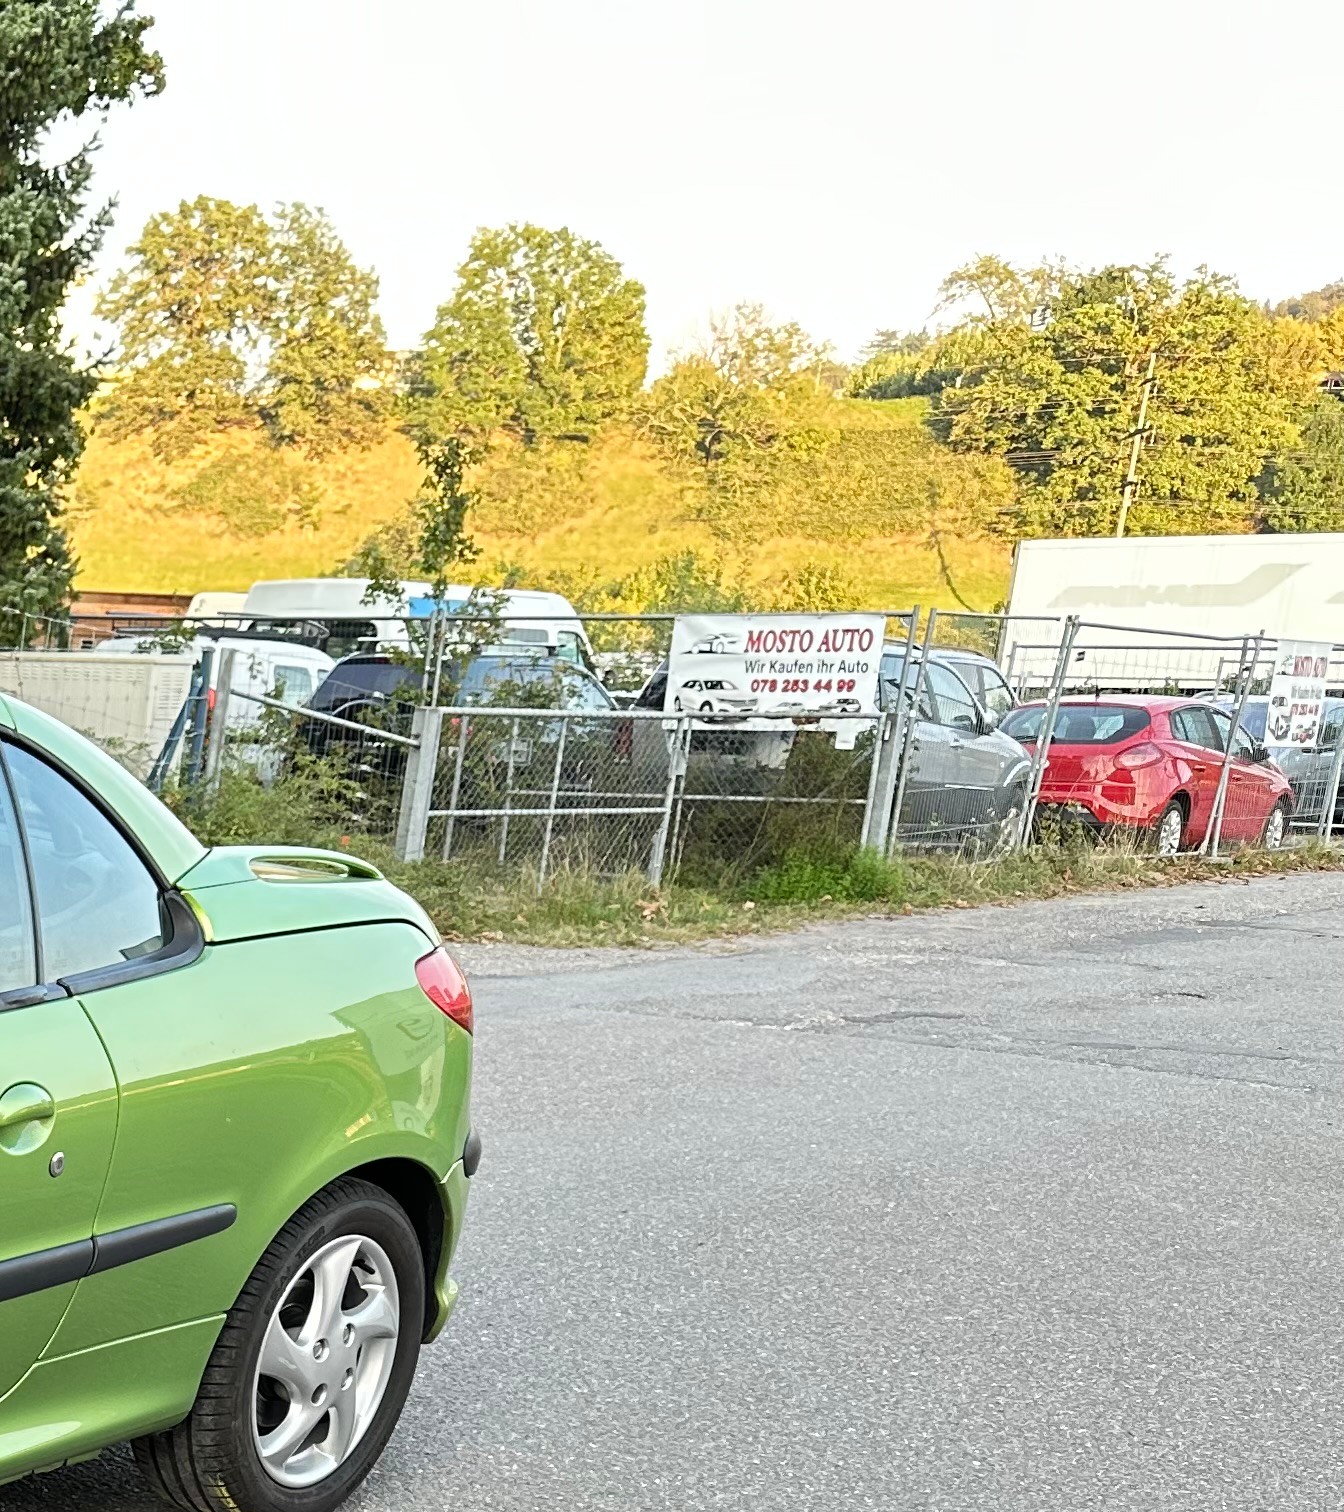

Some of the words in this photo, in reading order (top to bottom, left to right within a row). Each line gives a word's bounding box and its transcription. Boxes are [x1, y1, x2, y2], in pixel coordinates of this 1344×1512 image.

[743, 629, 814, 653] MOSTO
[816, 628, 874, 653] AUTO
[744, 660, 766, 674] Wir
[769, 659, 814, 674] Kaufen
[816, 659, 835, 674] ihr
[837, 659, 869, 674] Auto
[750, 679, 778, 693] 078
[813, 679, 833, 693] 44
